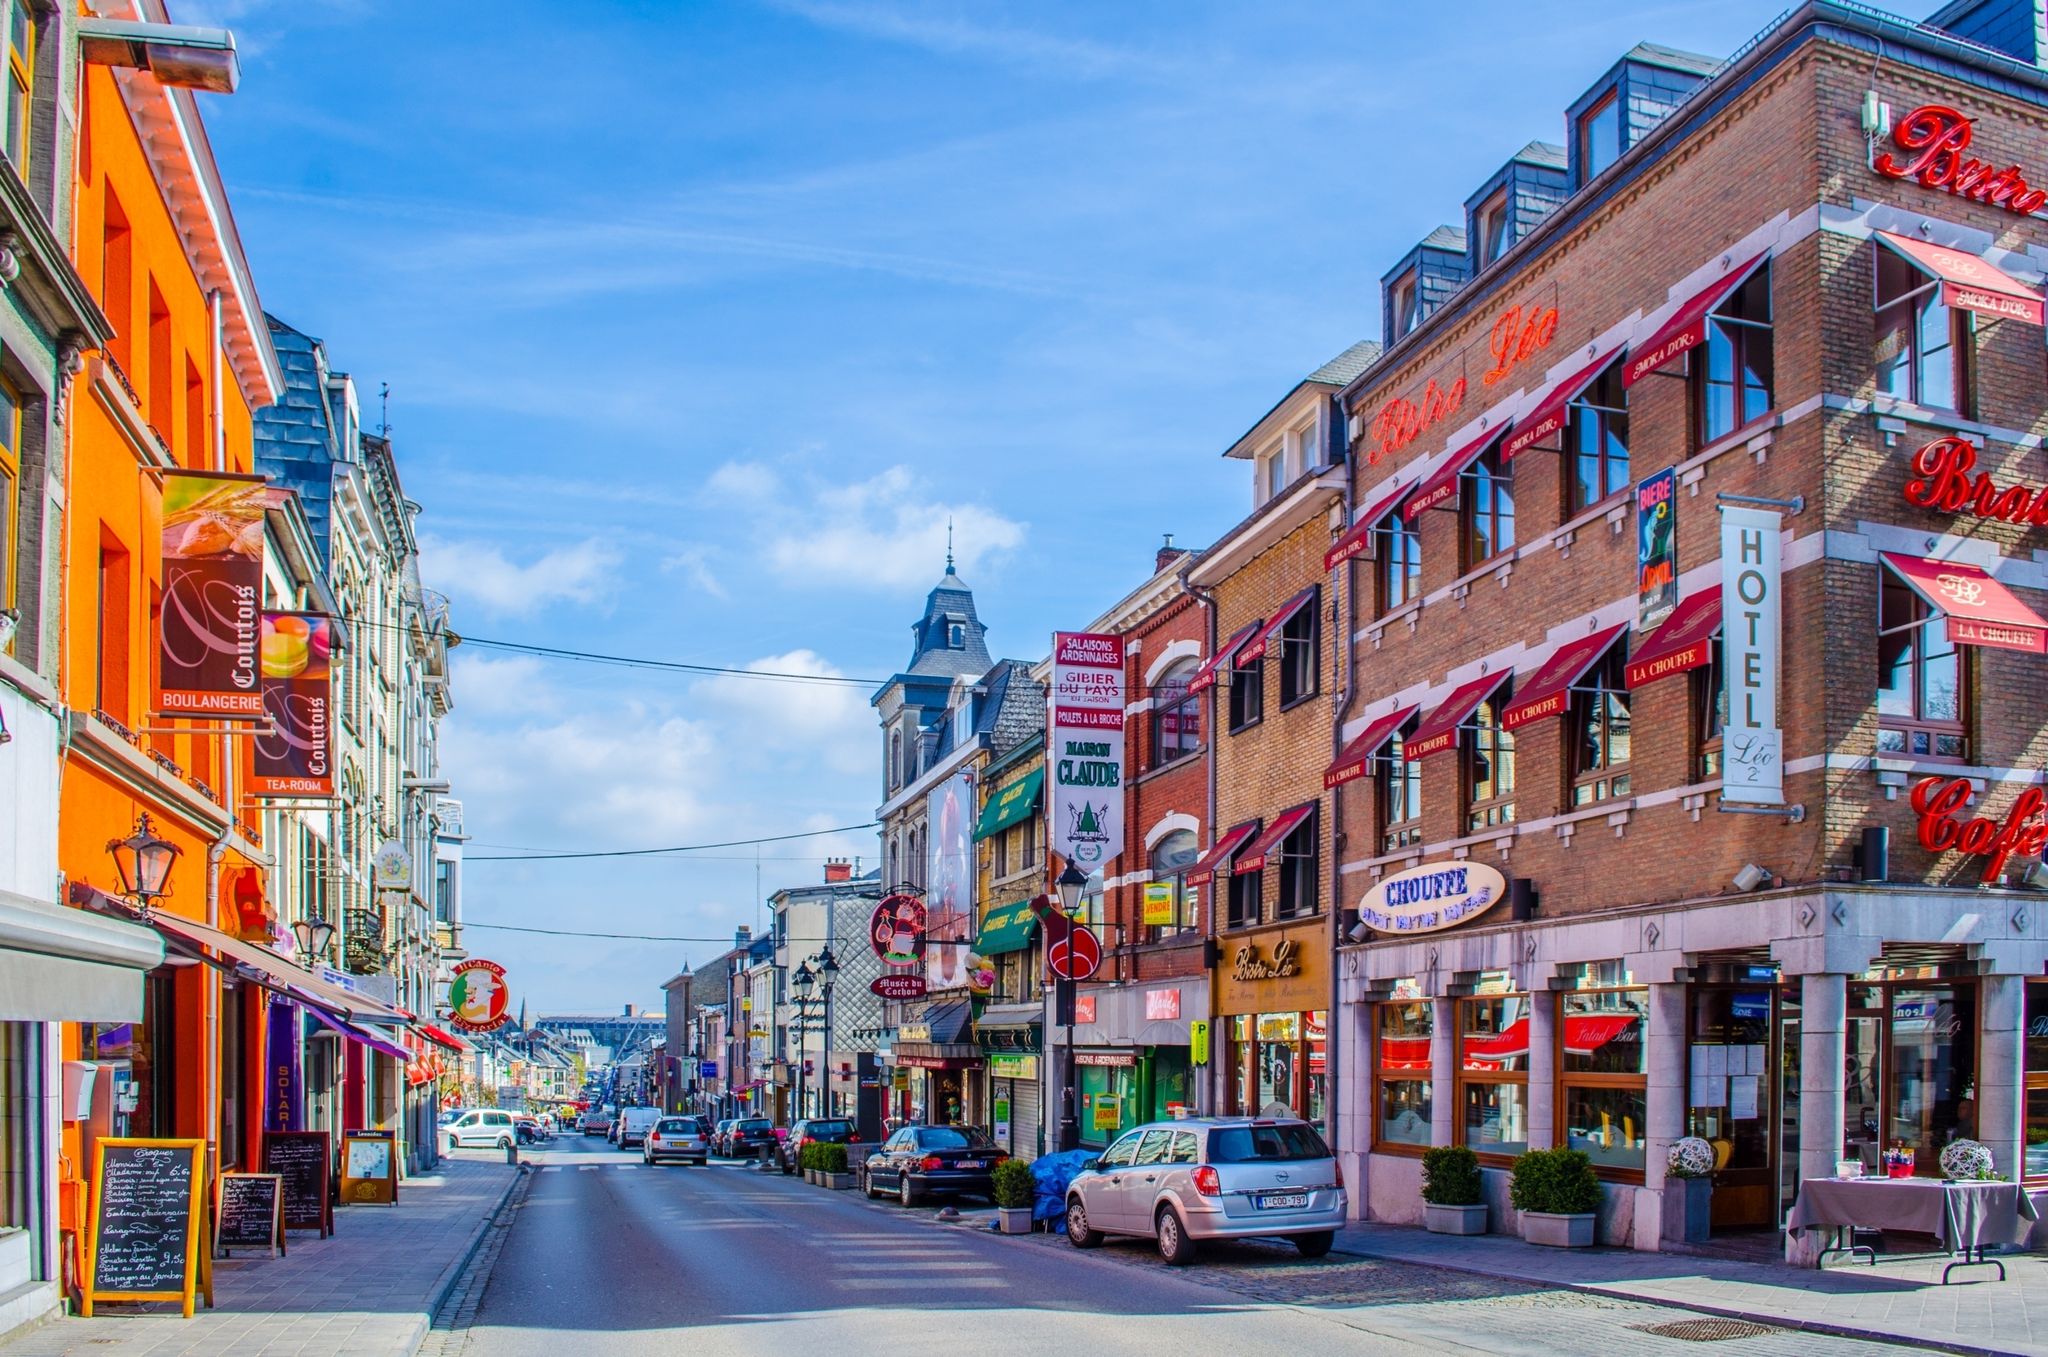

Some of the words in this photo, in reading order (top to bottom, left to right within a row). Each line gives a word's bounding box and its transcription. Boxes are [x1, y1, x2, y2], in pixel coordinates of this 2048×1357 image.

[1368, 377, 1467, 465] Bistro
[1483, 304, 1559, 385] Léo
[1640, 476, 1671, 511] BIERE
[231, 585, 255, 688] Courtois
[1737, 529, 1767, 729] HOTEL
[1958, 624, 1975, 638] LA
[1980, 626, 2036, 646] CHOUFFE
[1067, 638, 1113, 652] SALAISONS
[1060, 650, 1118, 664] ARDENNAISES
[1633, 669, 1646, 682] LA
[1649, 649, 1696, 676] CHOUFFE
[1065, 672, 1115, 685] GIBIER
[1060, 684, 1079, 694] DU
[1085, 685, 1119, 697] PAYS
[163, 693, 261, 711] BOULANGERIE
[1509, 712, 1520, 725] LA
[1522, 697, 1558, 720] CHOUFFE
[1058, 712, 1082, 724] POULETS
[1089, 714, 1098, 724] LA
[1099, 714, 1122, 726] BROCHE
[308, 697, 325, 776] Courtois
[1408, 746, 1417, 757] LA
[1419, 734, 1449, 754] CHOUFFE
[1065, 741, 1111, 758] MAISON
[1730, 733, 1776, 765] Léo
[1057, 759, 1120, 787] CLAUDE
[1328, 775, 1335, 785] LA
[1336, 764, 1361, 782] CHOUFFE
[1747, 766, 1760, 782] 2
[266, 779, 321, 792] TEA-ROOM
[1236, 863, 1242, 872] LA
[1243, 857, 1262, 869] CHOUFFE
[1187, 876, 1193, 885] LA
[1193, 872, 1210, 883] CHOUFFE
[1384, 867, 1468, 907] CHOUFFE
[1231, 946, 1266, 981] Bistro
[1268, 940, 1294, 978] Léo
[880, 979, 908, 987] Musée
[912, 979, 922, 987] du
[884, 988, 917, 996] Cochon
[453, 1015, 505, 1032] Pizzeria
[1199, 1024, 1206, 1034] P
[1576, 1022, 1610, 1042] Salad
[1611, 1023, 1638, 1042] Bar
[1075, 1055, 1094, 1064] AISONS
[1095, 1056, 1131, 1065] ARDENNAISES
